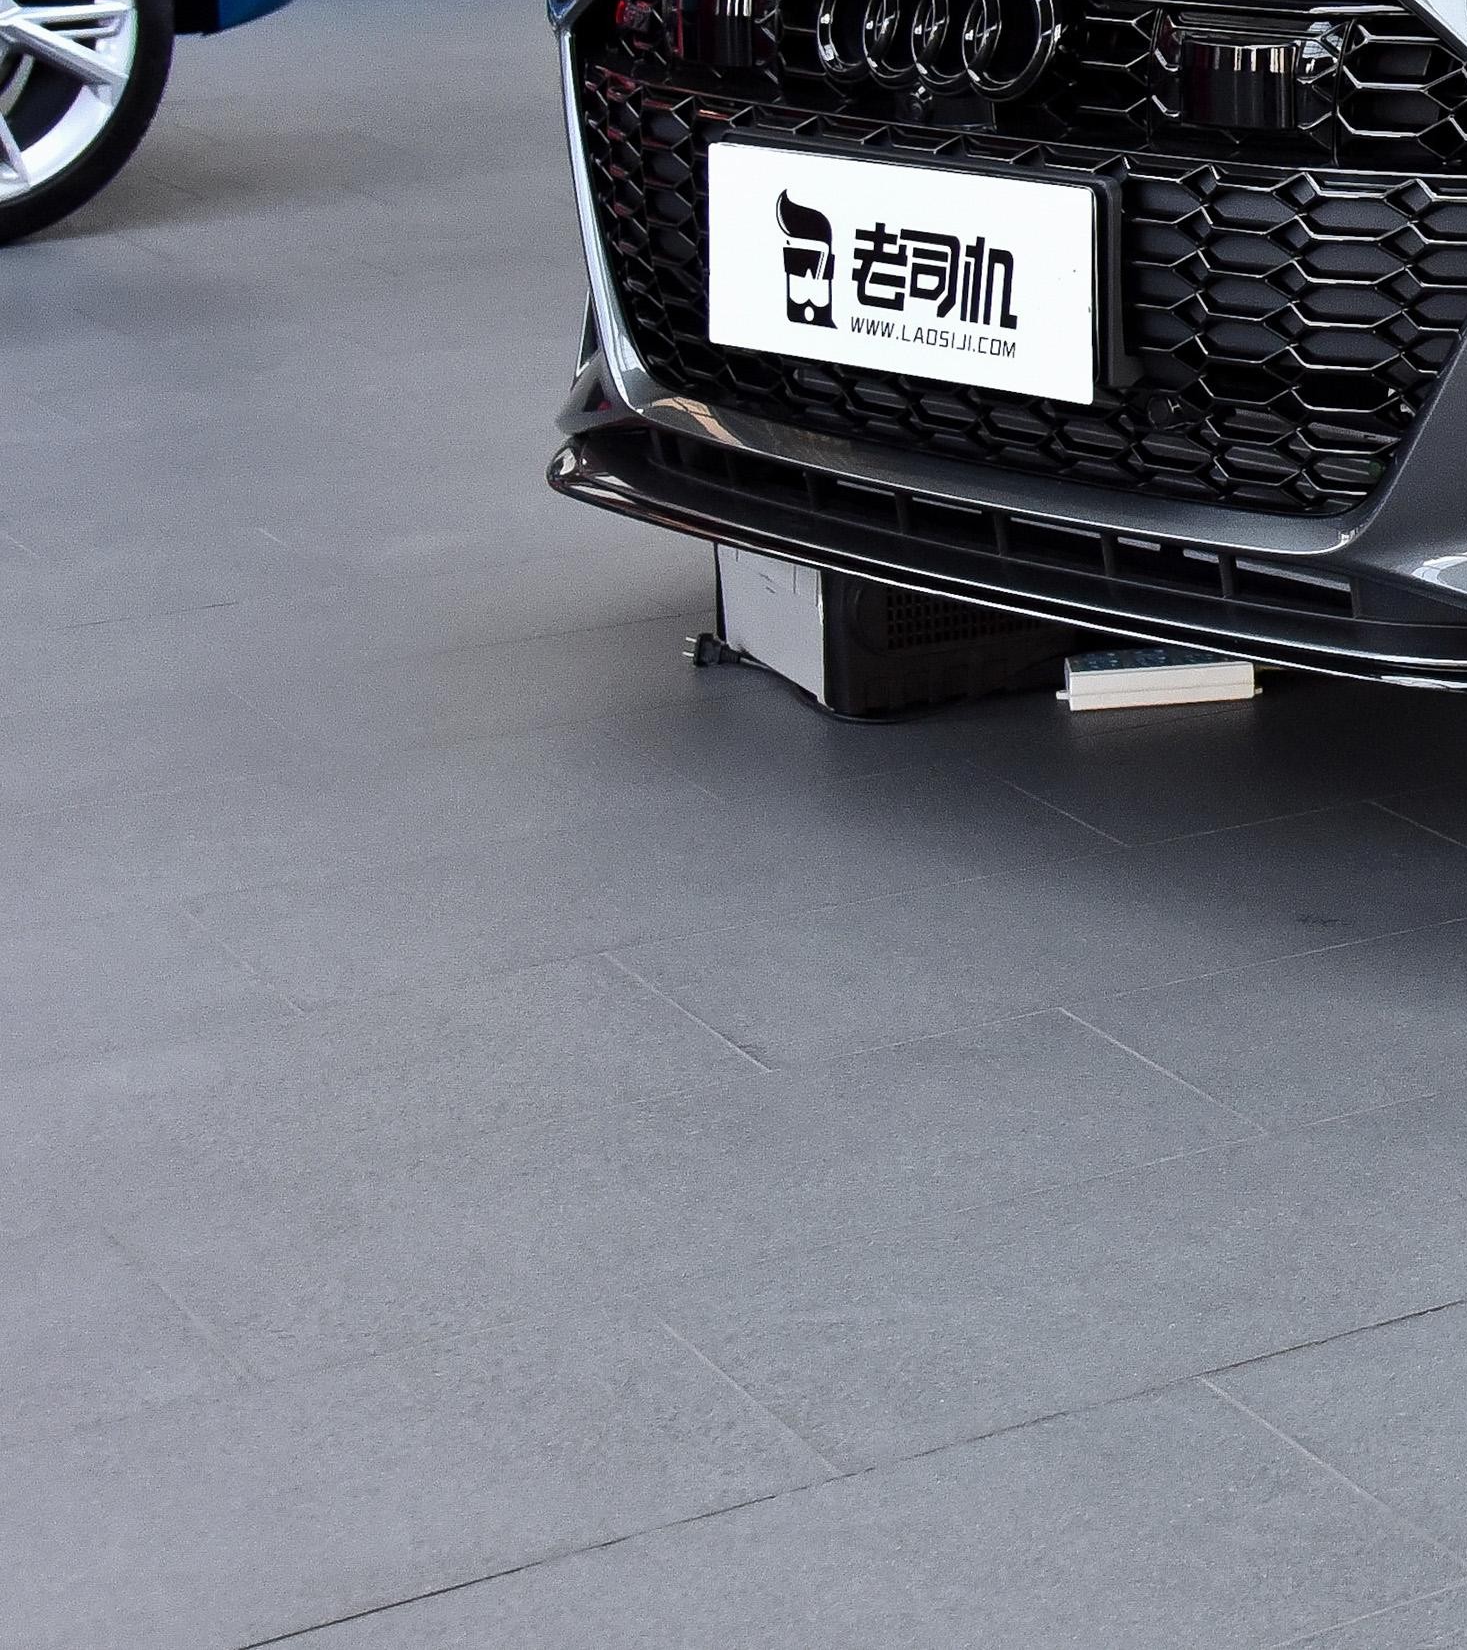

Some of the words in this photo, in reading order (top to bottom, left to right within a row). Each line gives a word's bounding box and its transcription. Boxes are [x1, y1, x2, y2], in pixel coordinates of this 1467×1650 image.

[852, 222, 1017, 329] 老司机
[851, 316, 1016, 358] WWW.LAOSIJI.COM
